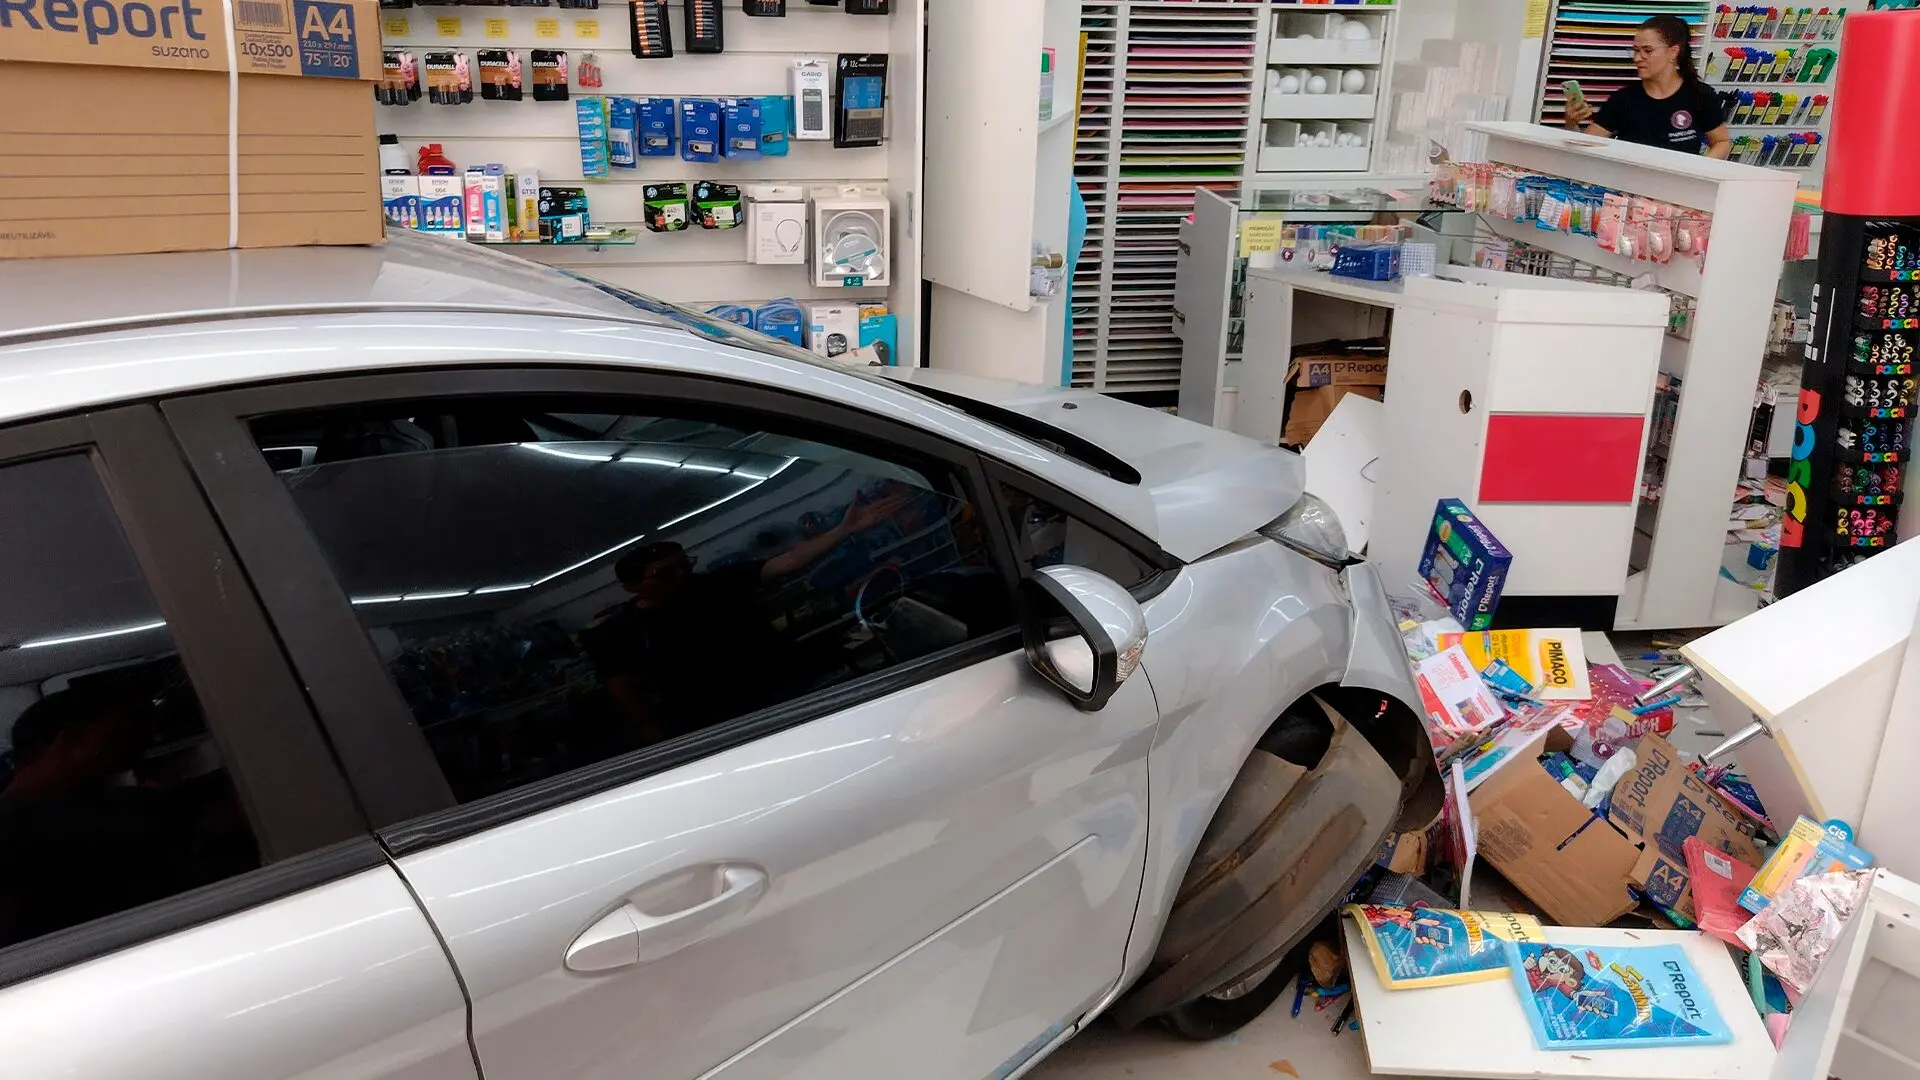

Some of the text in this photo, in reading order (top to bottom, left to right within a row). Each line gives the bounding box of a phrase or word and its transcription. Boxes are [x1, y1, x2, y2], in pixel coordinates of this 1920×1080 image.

[302, 5, 353, 42] A4
[151, 45, 210, 60] suzano
[240, 42, 294, 58] 10x500
[1890, 270, 1920, 281] POSC
[1882, 318, 1919, 329] POSCA
[1310, 364, 1330, 376] A4
[1347, 362, 1387, 374] Repor
[1876, 364, 1912, 375] POSCA
[1870, 407, 1905, 418] POSCA
[1863, 452, 1899, 462] POSCA
[1857, 495, 1892, 505] POSCA
[1850, 536, 1885, 546] POSCA
[1458, 570, 1482, 622] Report
[1480, 575, 1497, 606] Report
[1547, 641, 1568, 686] PIMACO
[1628, 758, 1666, 809] Report
[1677, 799, 1702, 821] A4
[1653, 864, 1684, 891] A4
[1501, 912, 1530, 943] port
[1668, 972, 1702, 1020] Report
